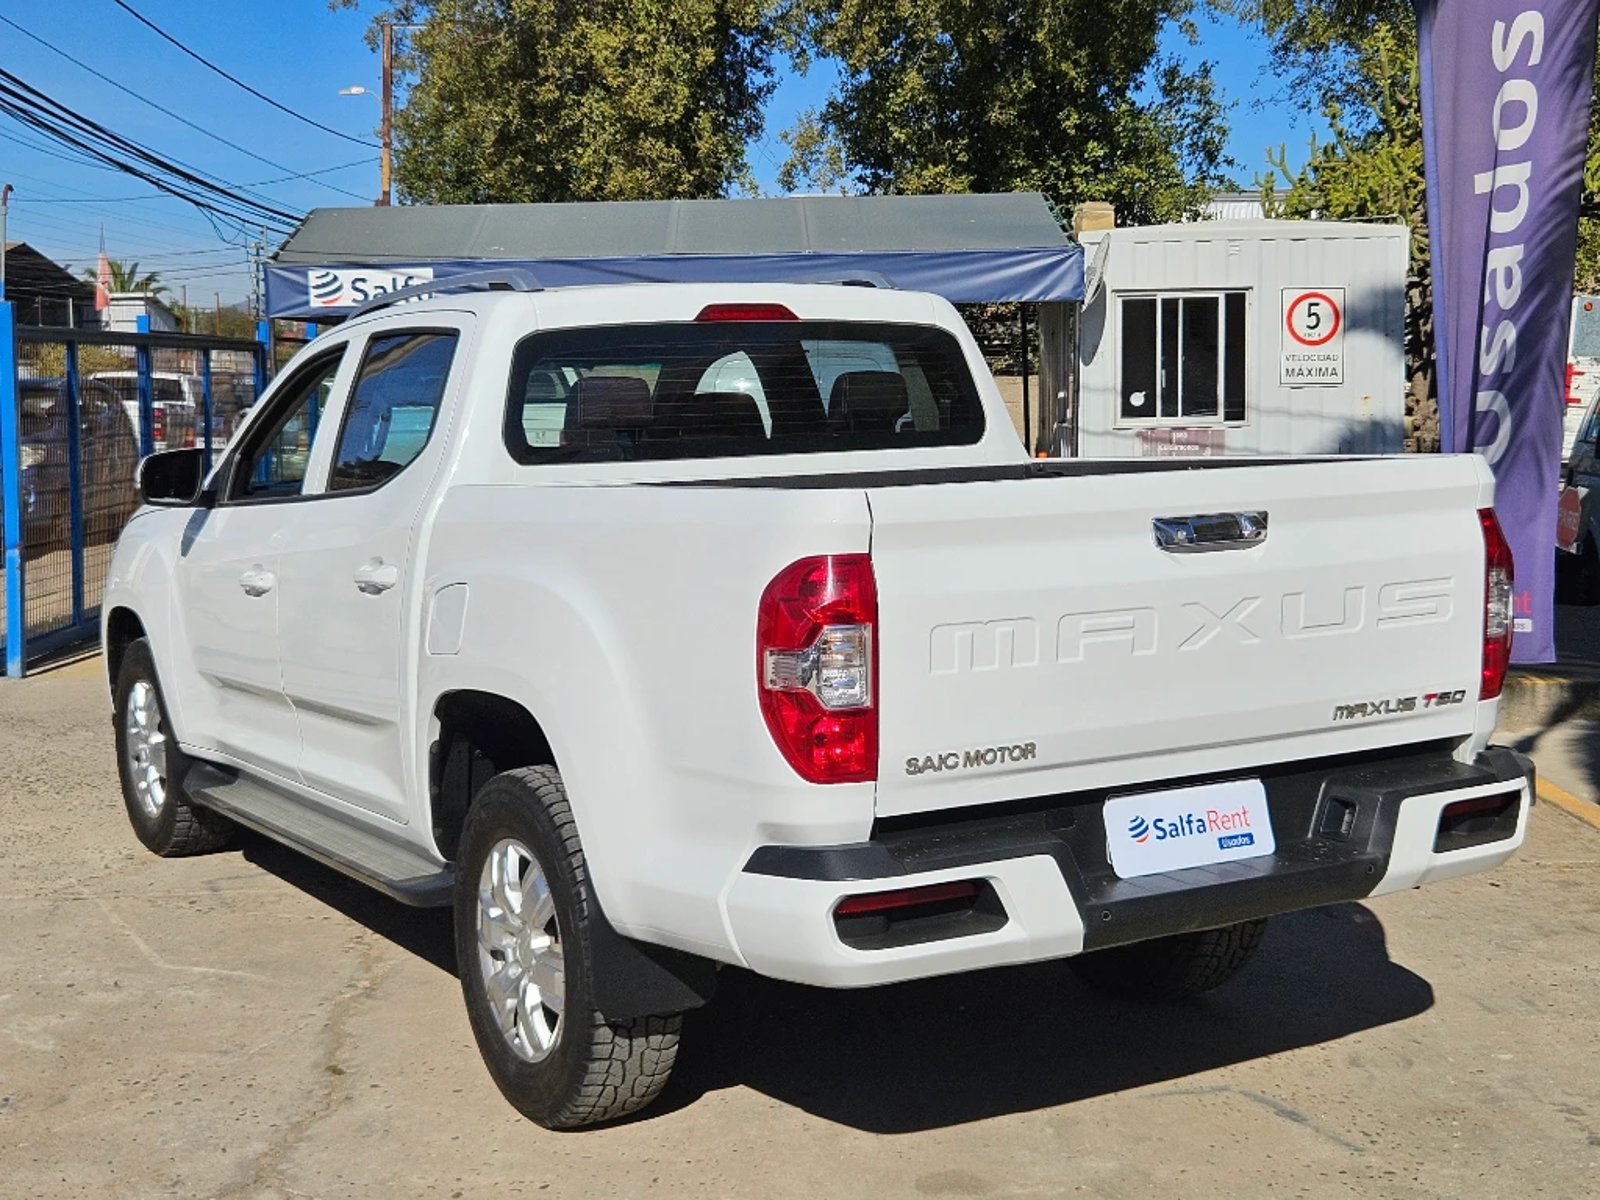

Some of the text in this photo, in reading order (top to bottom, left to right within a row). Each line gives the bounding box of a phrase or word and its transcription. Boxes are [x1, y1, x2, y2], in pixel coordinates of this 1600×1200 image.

[1473, 10, 1545, 466] Usados
[1306, 302, 1321, 330] 5
[1285, 366, 1339, 378] MÁXIMA
[928, 576, 1455, 676] MAXUS
[1332, 689, 1467, 721] MAXUS T60
[905, 741, 1037, 776] SAIC MOTOR
[1153, 805, 1251, 841] SalfaRent
[1221, 833, 1252, 849] Usados
